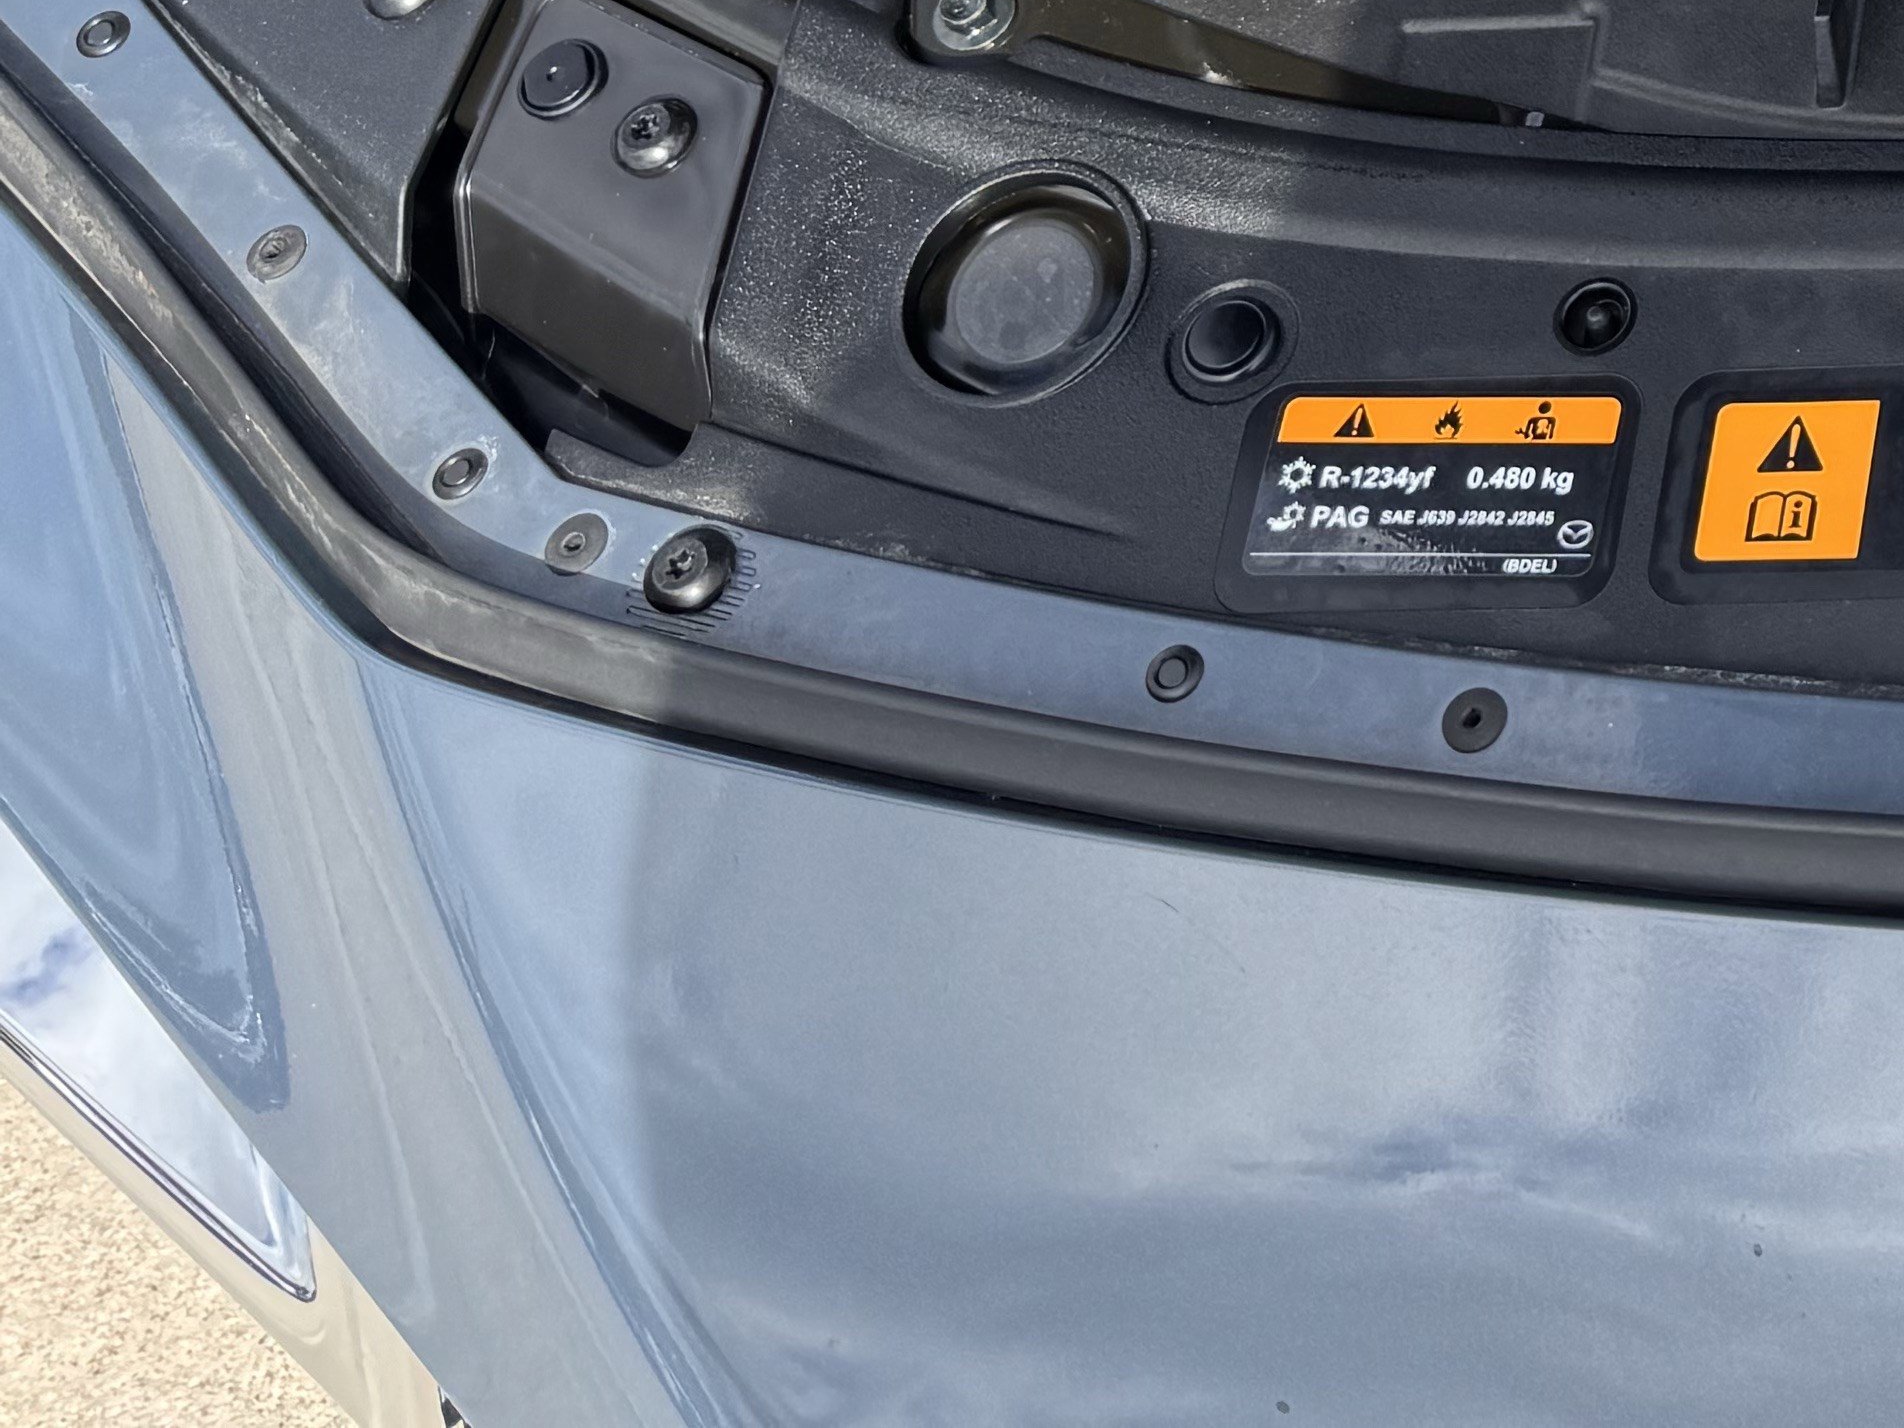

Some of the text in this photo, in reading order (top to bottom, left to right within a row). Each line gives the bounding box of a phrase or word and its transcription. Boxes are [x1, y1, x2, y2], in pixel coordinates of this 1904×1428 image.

[1318, 465, 1575, 495] R-1234yf 0.480 kg
[1310, 505, 1555, 529] PAG SAE J639 J2842 J2845
[1502, 558, 1557, 575] (BDEL)
